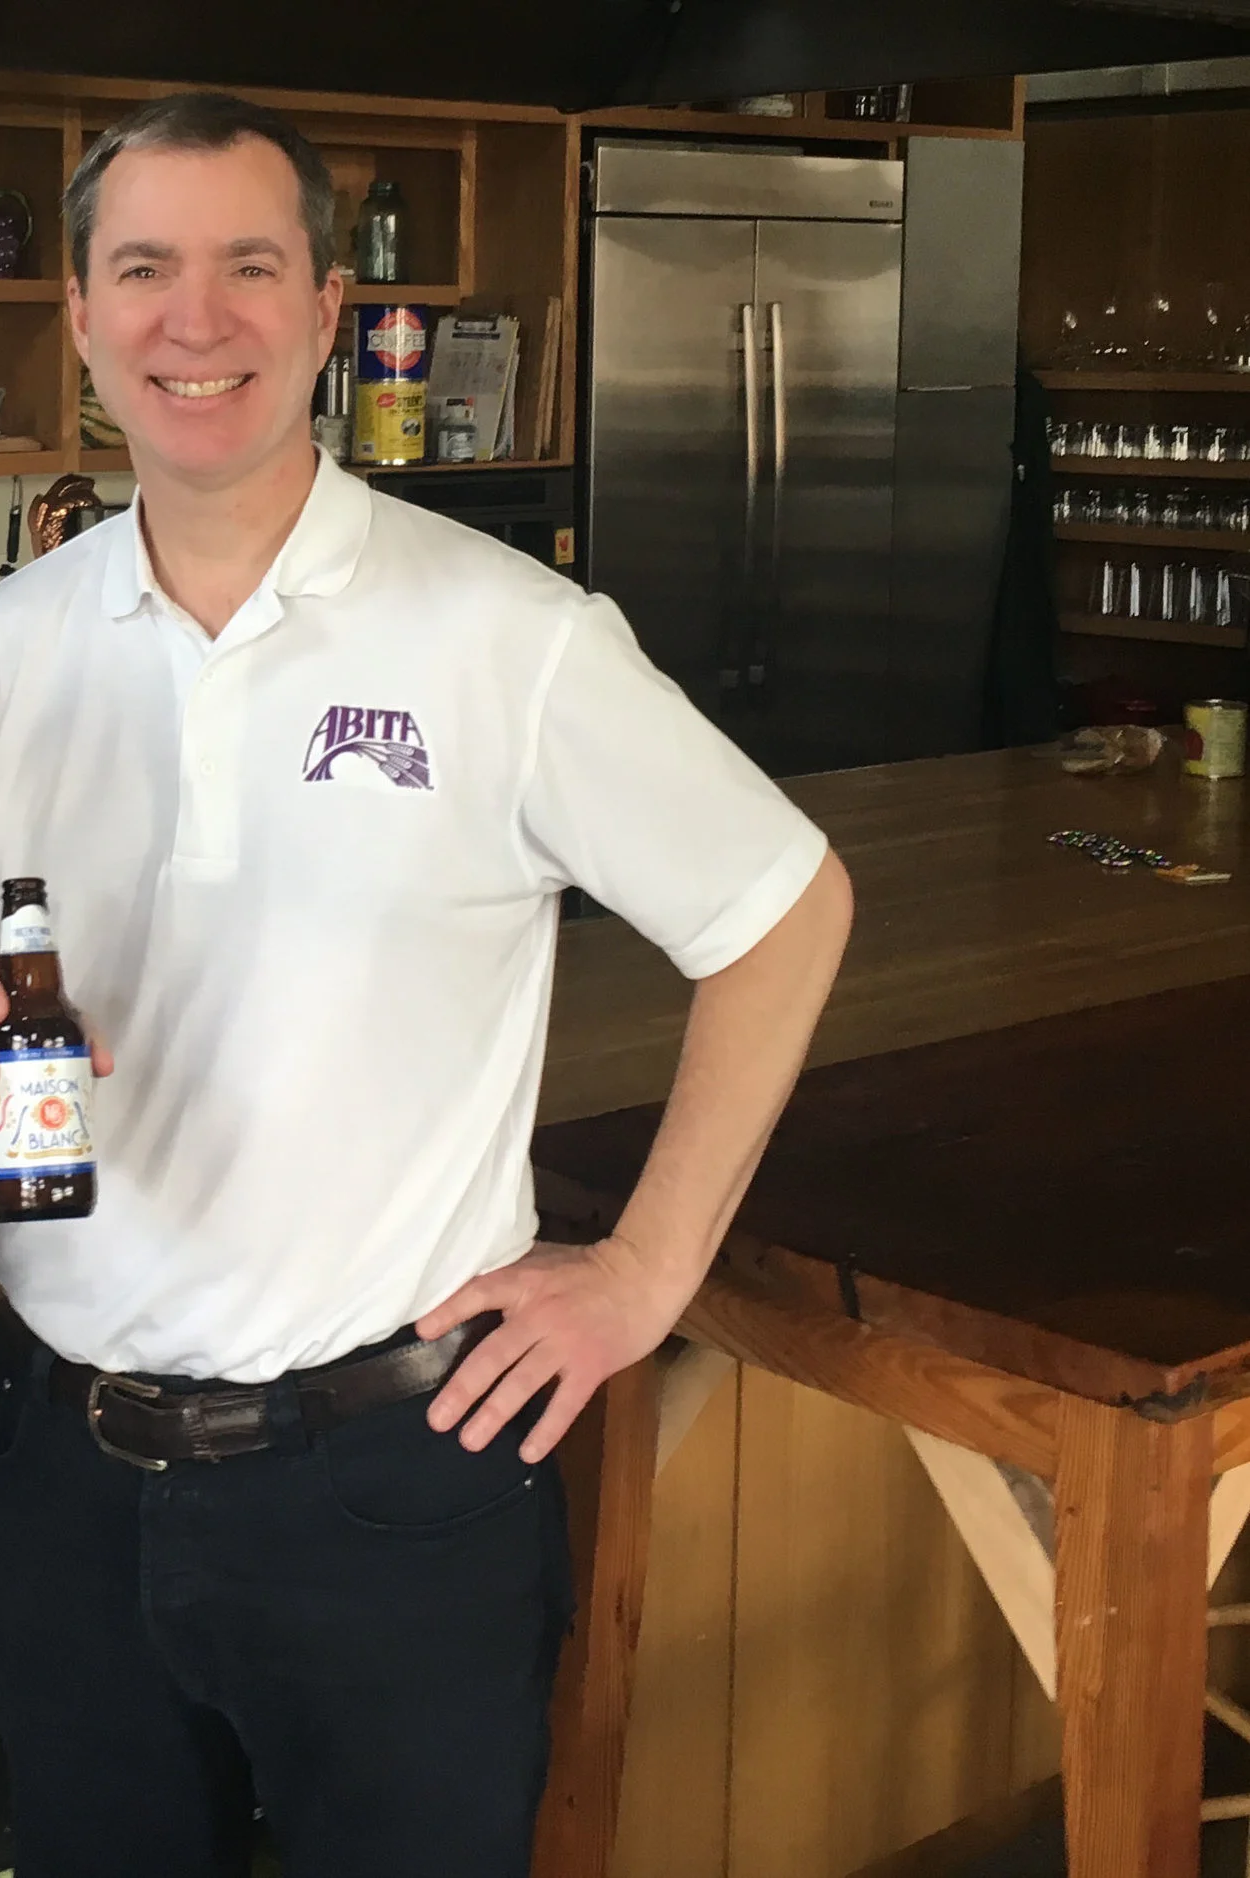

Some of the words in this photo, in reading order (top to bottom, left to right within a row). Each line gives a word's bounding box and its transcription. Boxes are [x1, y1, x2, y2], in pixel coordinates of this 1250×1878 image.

[302, 705, 425, 774] ABITA
[20, 1078, 78, 1094] MAISON
[28, 1130, 83, 1150] BLANC
